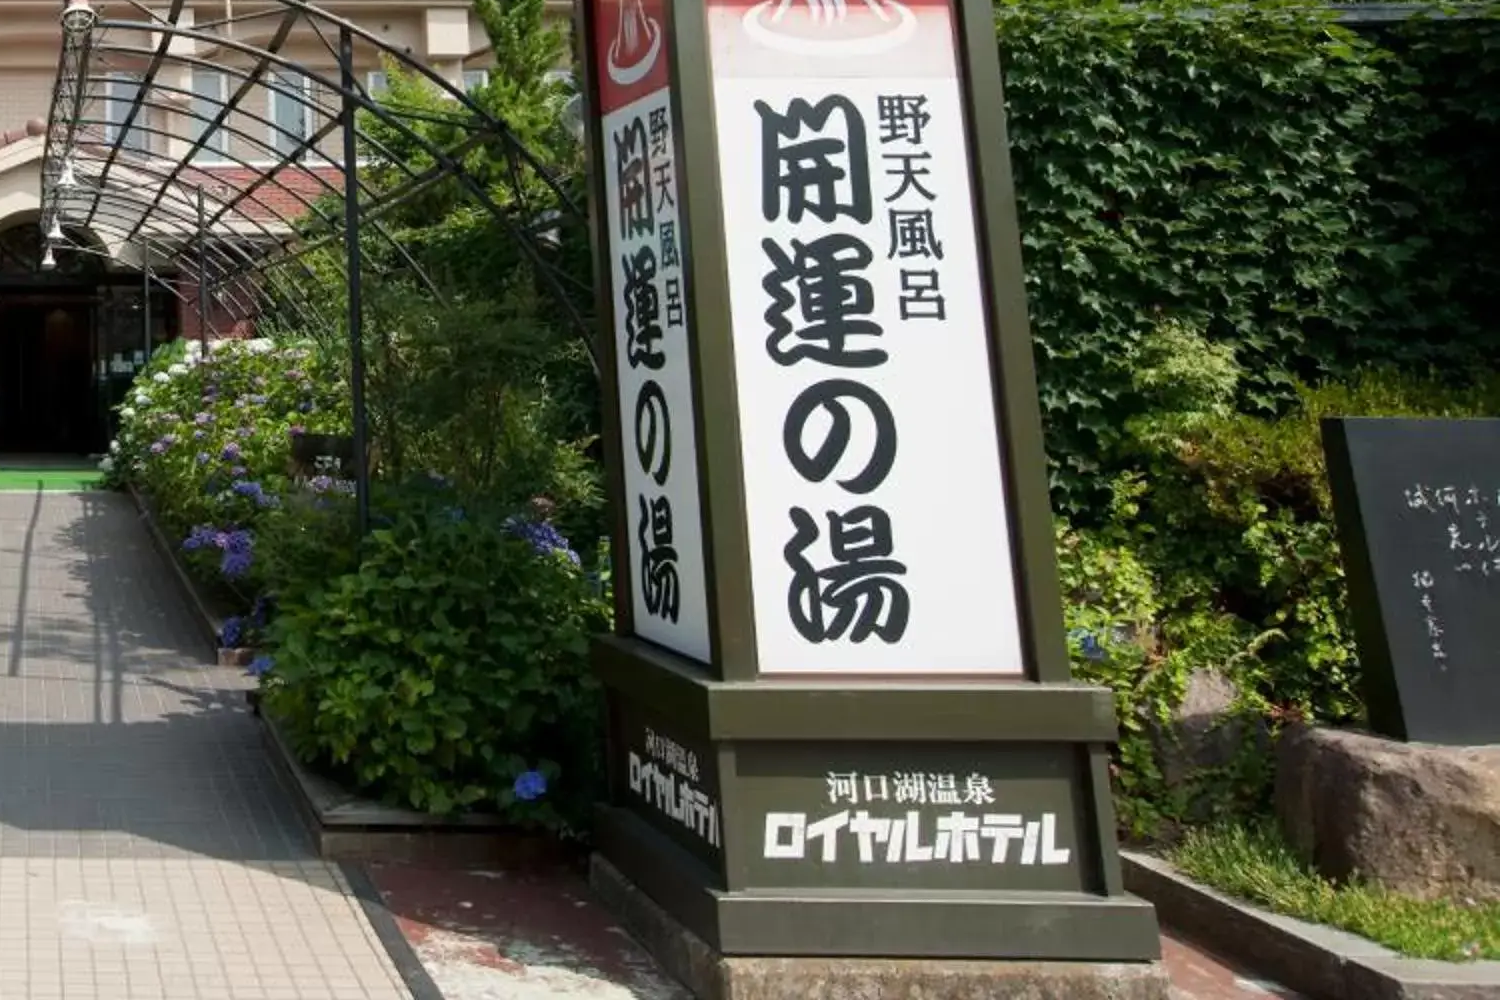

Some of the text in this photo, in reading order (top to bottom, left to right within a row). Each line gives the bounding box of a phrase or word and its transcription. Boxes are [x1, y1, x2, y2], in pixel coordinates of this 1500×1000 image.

[648, 107, 684, 329] 野天風呂
[877, 94, 947, 322] 野天風呂
[613, 115, 680, 625] 開運の湯
[753, 93, 910, 644] 開運の湯
[763, 809, 1071, 865] ロイヤルホテル
[825, 770, 997, 805] 河口湖温泉
